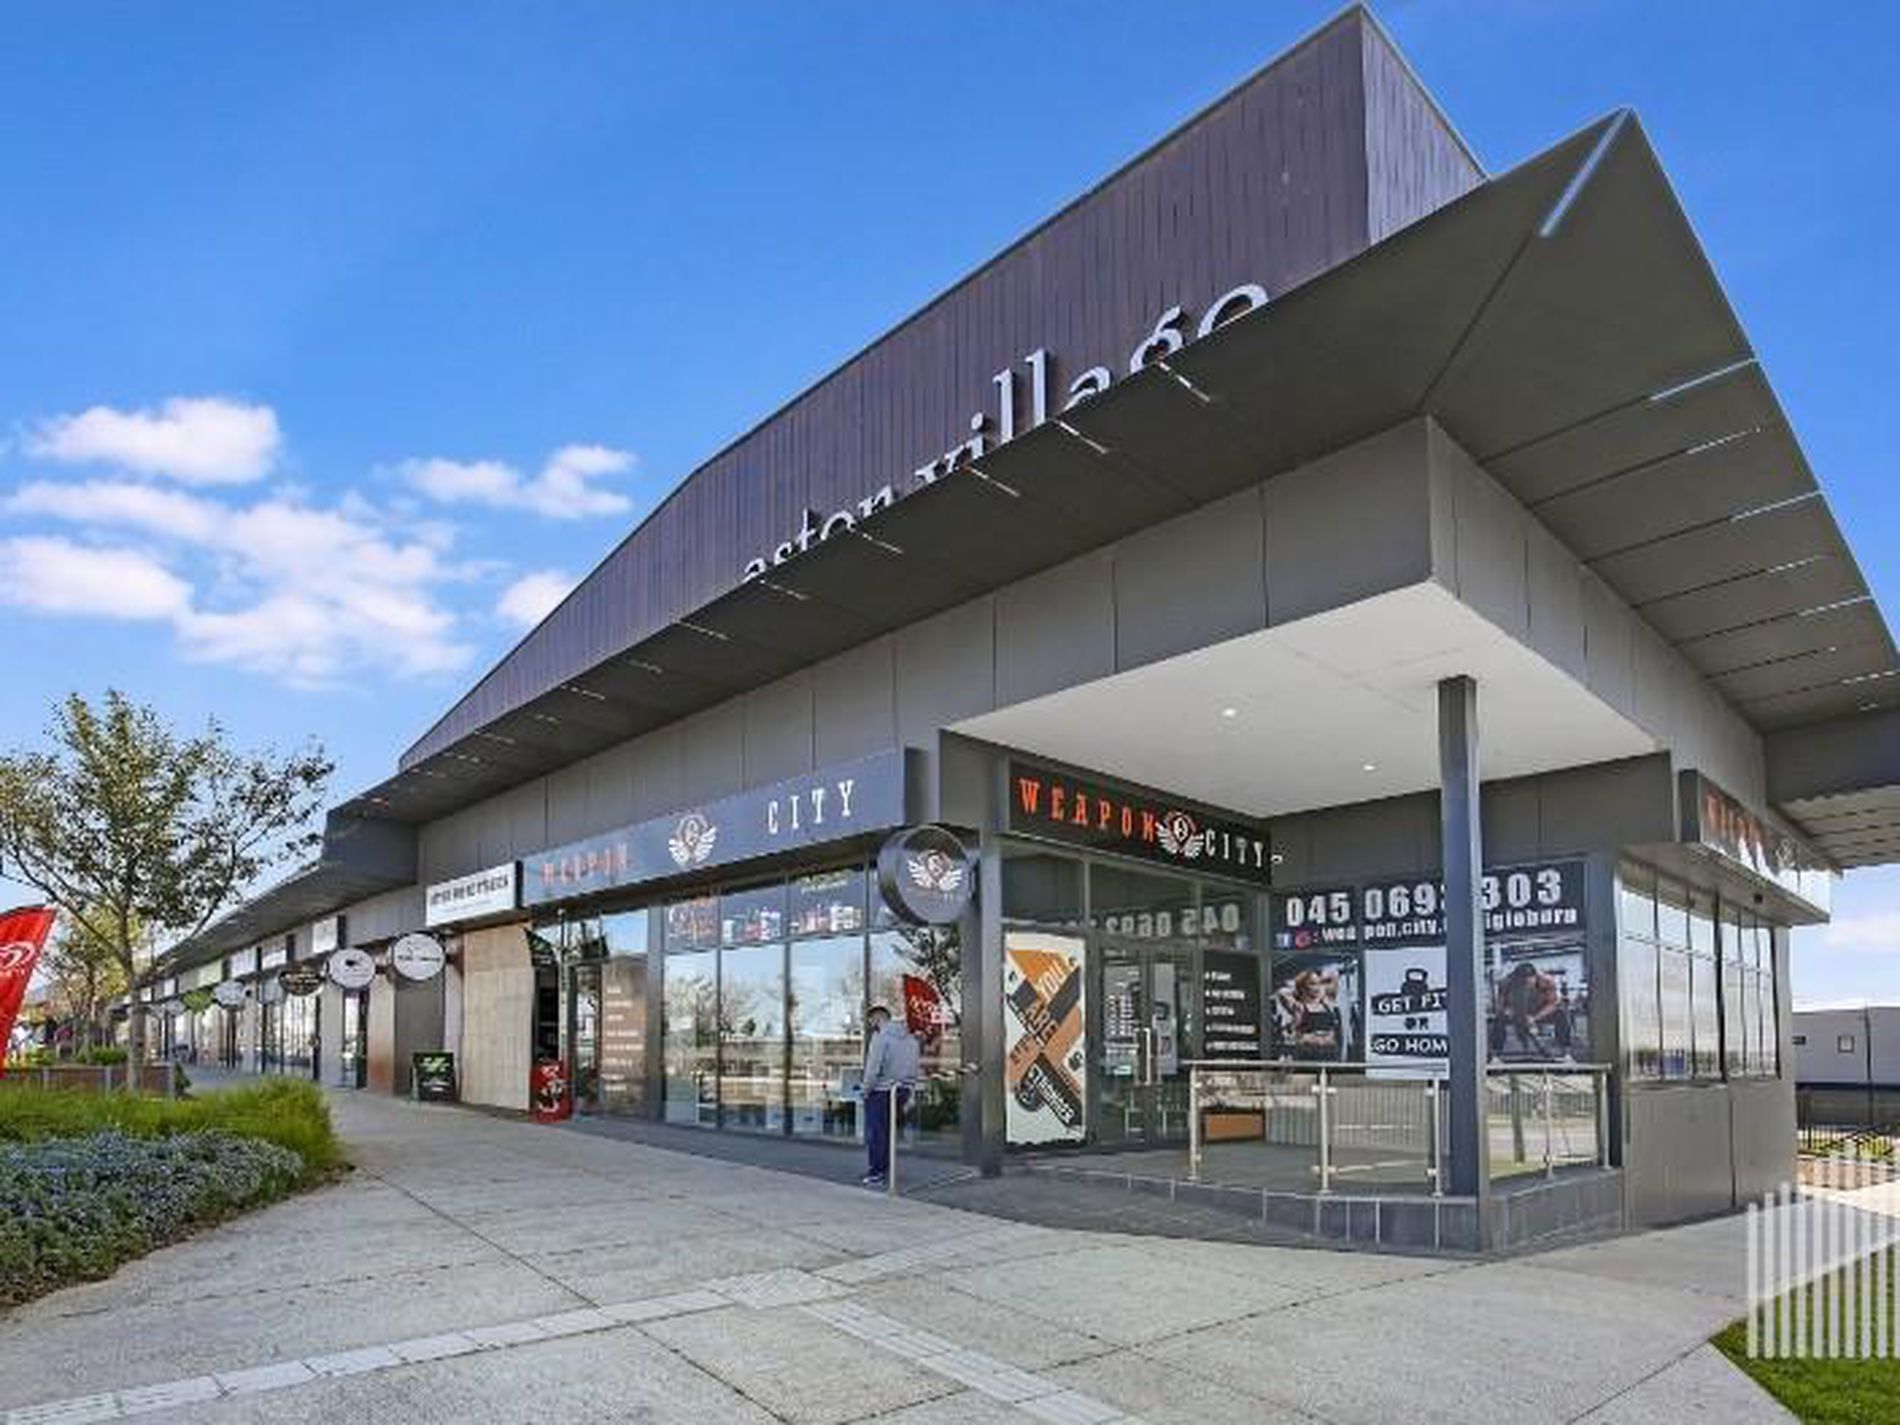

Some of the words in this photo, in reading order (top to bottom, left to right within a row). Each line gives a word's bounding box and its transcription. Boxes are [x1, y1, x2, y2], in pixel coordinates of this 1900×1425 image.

[767, 779, 856, 835] CITY
[1020, 778, 1157, 843] WEAPON
[1205, 828, 1265, 868] CITY
[1286, 891, 1352, 927] 045
[1364, 881, 1447, 920] 069
[1481, 868, 1562, 911] 303
[1378, 995, 1412, 1014] GET
[1403, 1016, 1429, 1031] OR
[1374, 1037, 1400, 1053] GO
